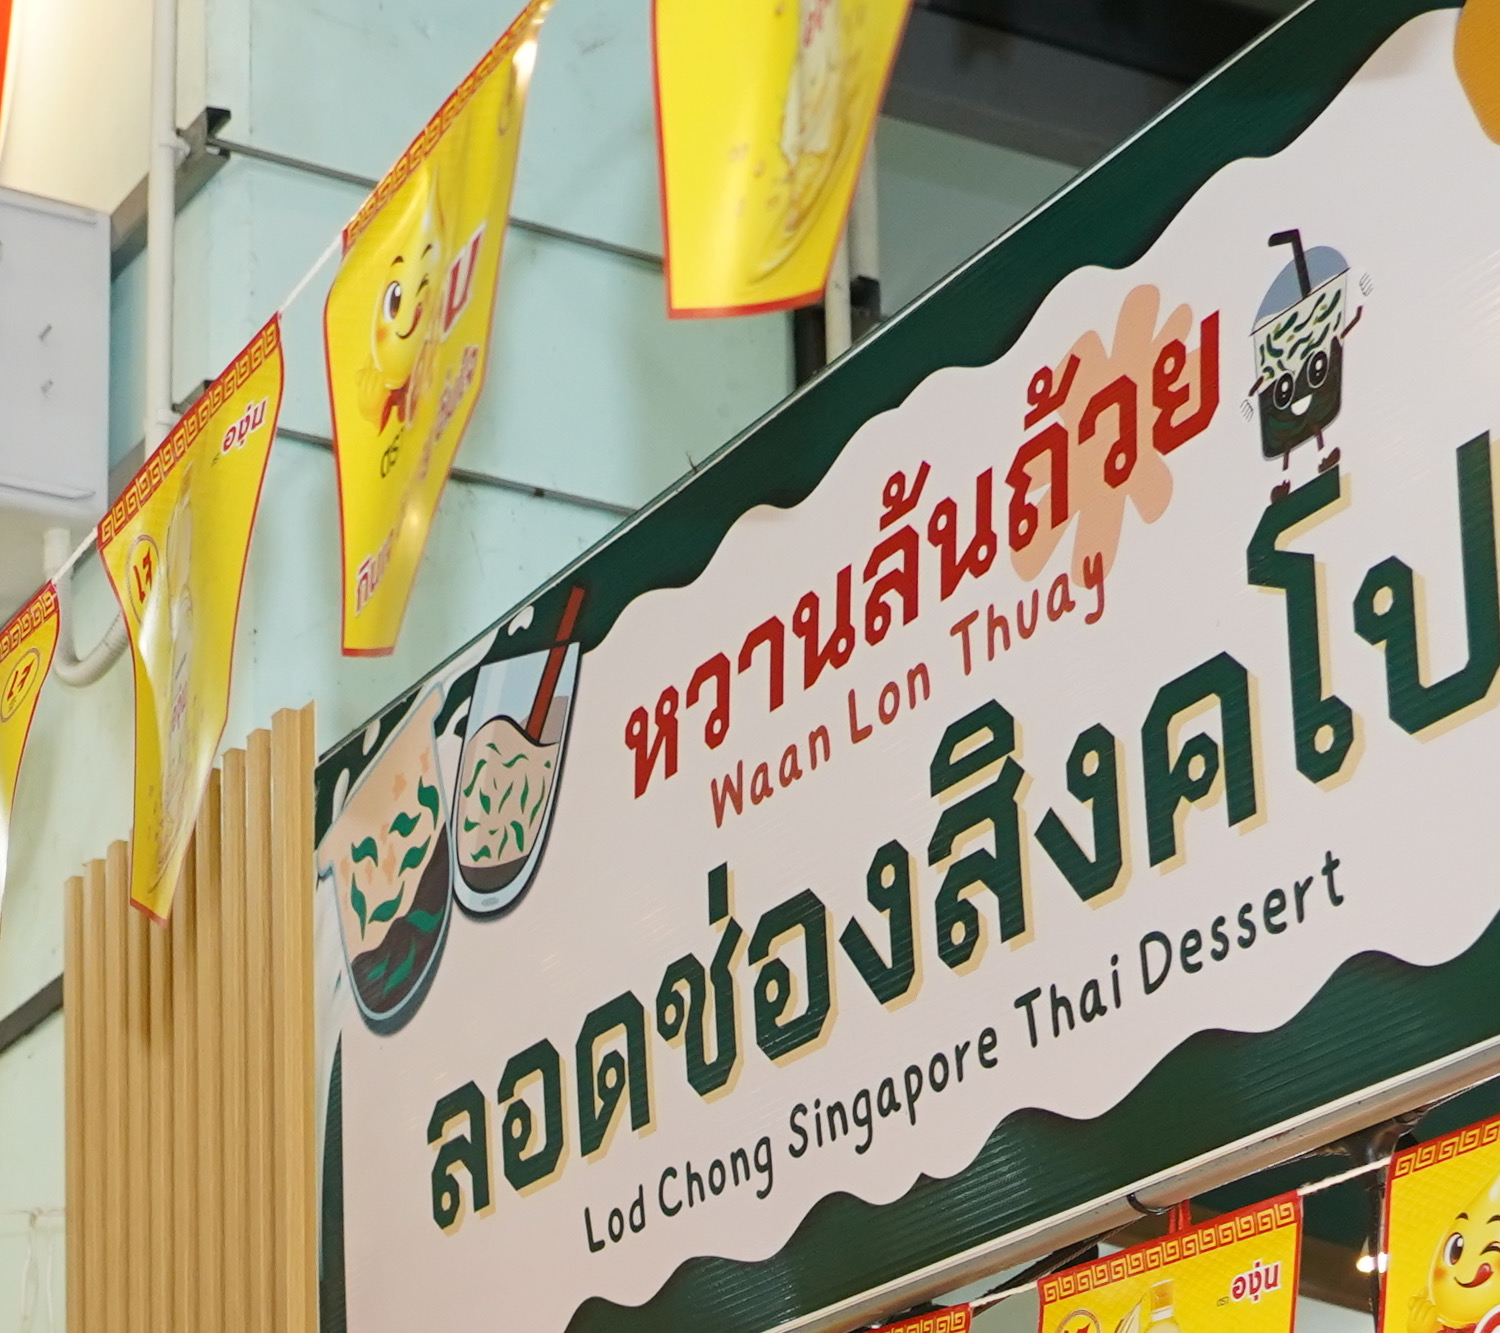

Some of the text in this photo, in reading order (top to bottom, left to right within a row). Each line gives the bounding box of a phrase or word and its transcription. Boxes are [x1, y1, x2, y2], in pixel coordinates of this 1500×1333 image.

[221, 398, 268, 454] องุ่น
[625, 310, 1221, 799] หวานล้นถ้วย
[711, 551, 1107, 828] Waan Lon Thuay
[583, 850, 1346, 1254] Lod Chong Singapore Thai Dessert
[1229, 1260, 1282, 1306] องุ่น
